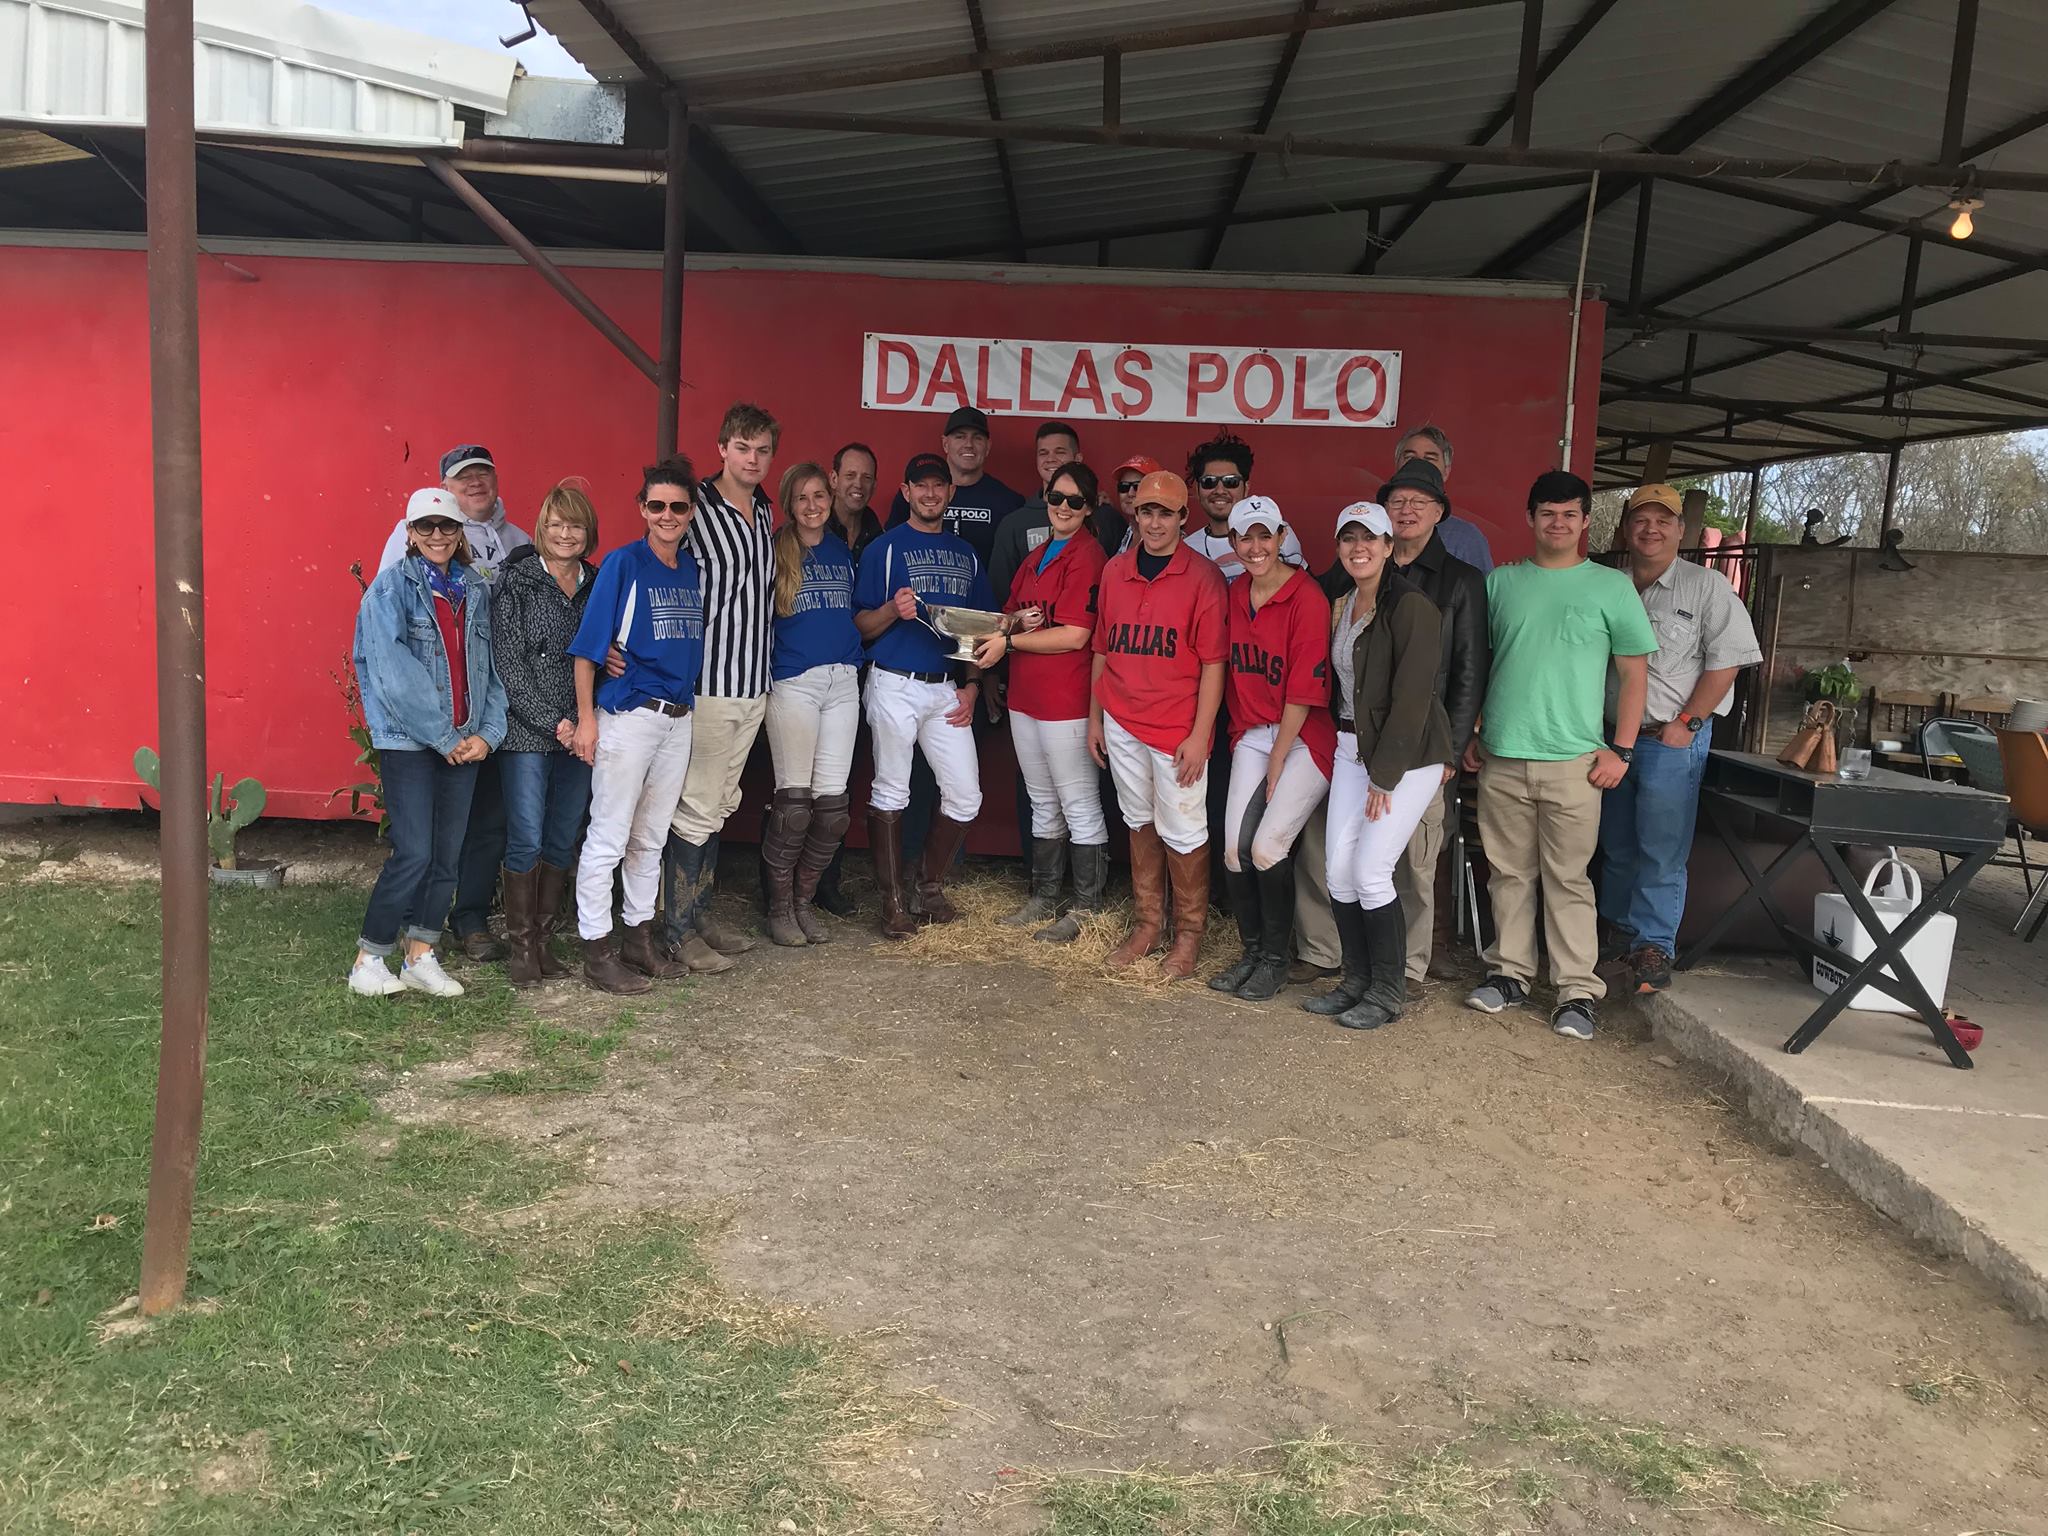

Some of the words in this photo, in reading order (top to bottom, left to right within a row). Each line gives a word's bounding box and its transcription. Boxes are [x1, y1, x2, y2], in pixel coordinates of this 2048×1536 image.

[875, 340, 1153, 417] DALLAS
[1186, 352, 1388, 423] POLO
[961, 510, 988, 519] POLO
[903, 549, 936, 567] DALLAS
[936, 549, 955, 567] POLO
[813, 564, 833, 580] POLO
[648, 587, 679, 607] DALLAS
[653, 619, 685, 640] DOUBLE
[1107, 622, 1178, 659] DALLAS
